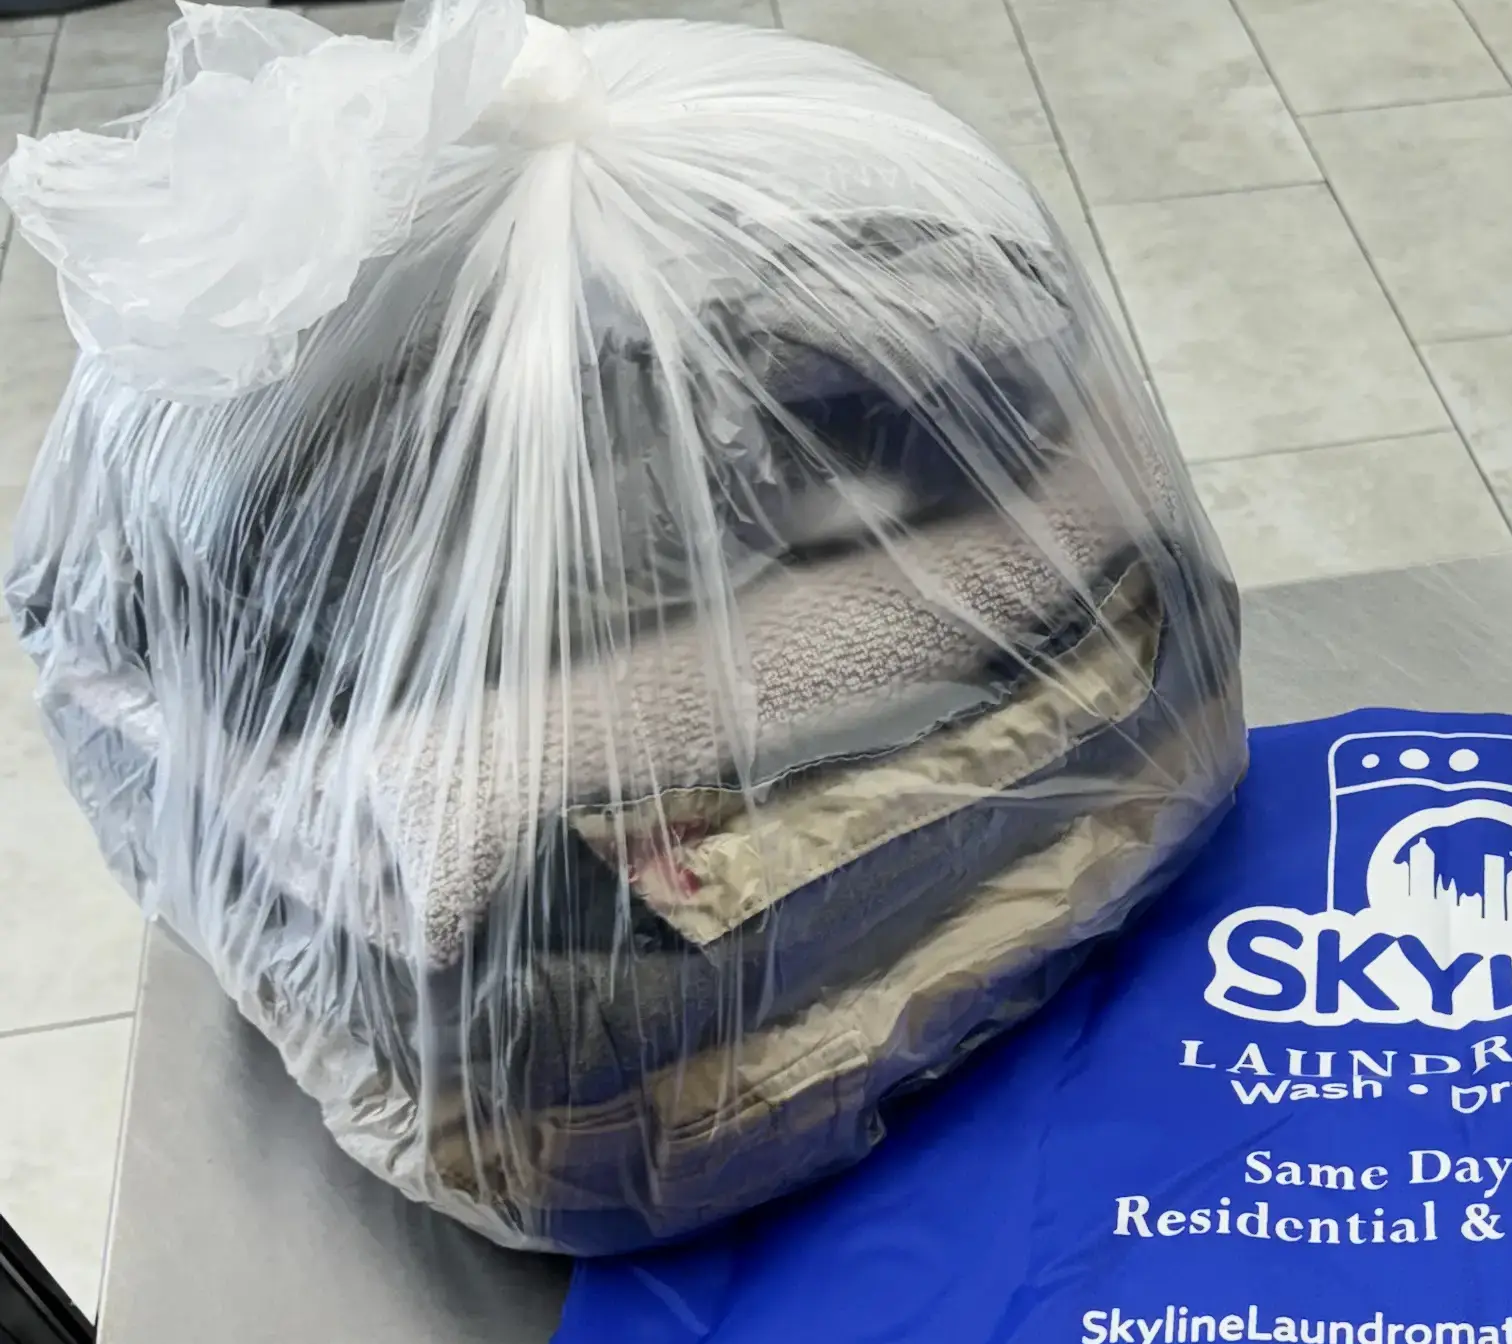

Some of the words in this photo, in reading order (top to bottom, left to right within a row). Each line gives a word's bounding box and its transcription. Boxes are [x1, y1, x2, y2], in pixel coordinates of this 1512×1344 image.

[1231, 1075, 1383, 1106] Wash
[1245, 1150, 1388, 1190] Same
[1113, 1195, 1438, 1245] Residential
[1460, 1203, 1505, 1242] &
